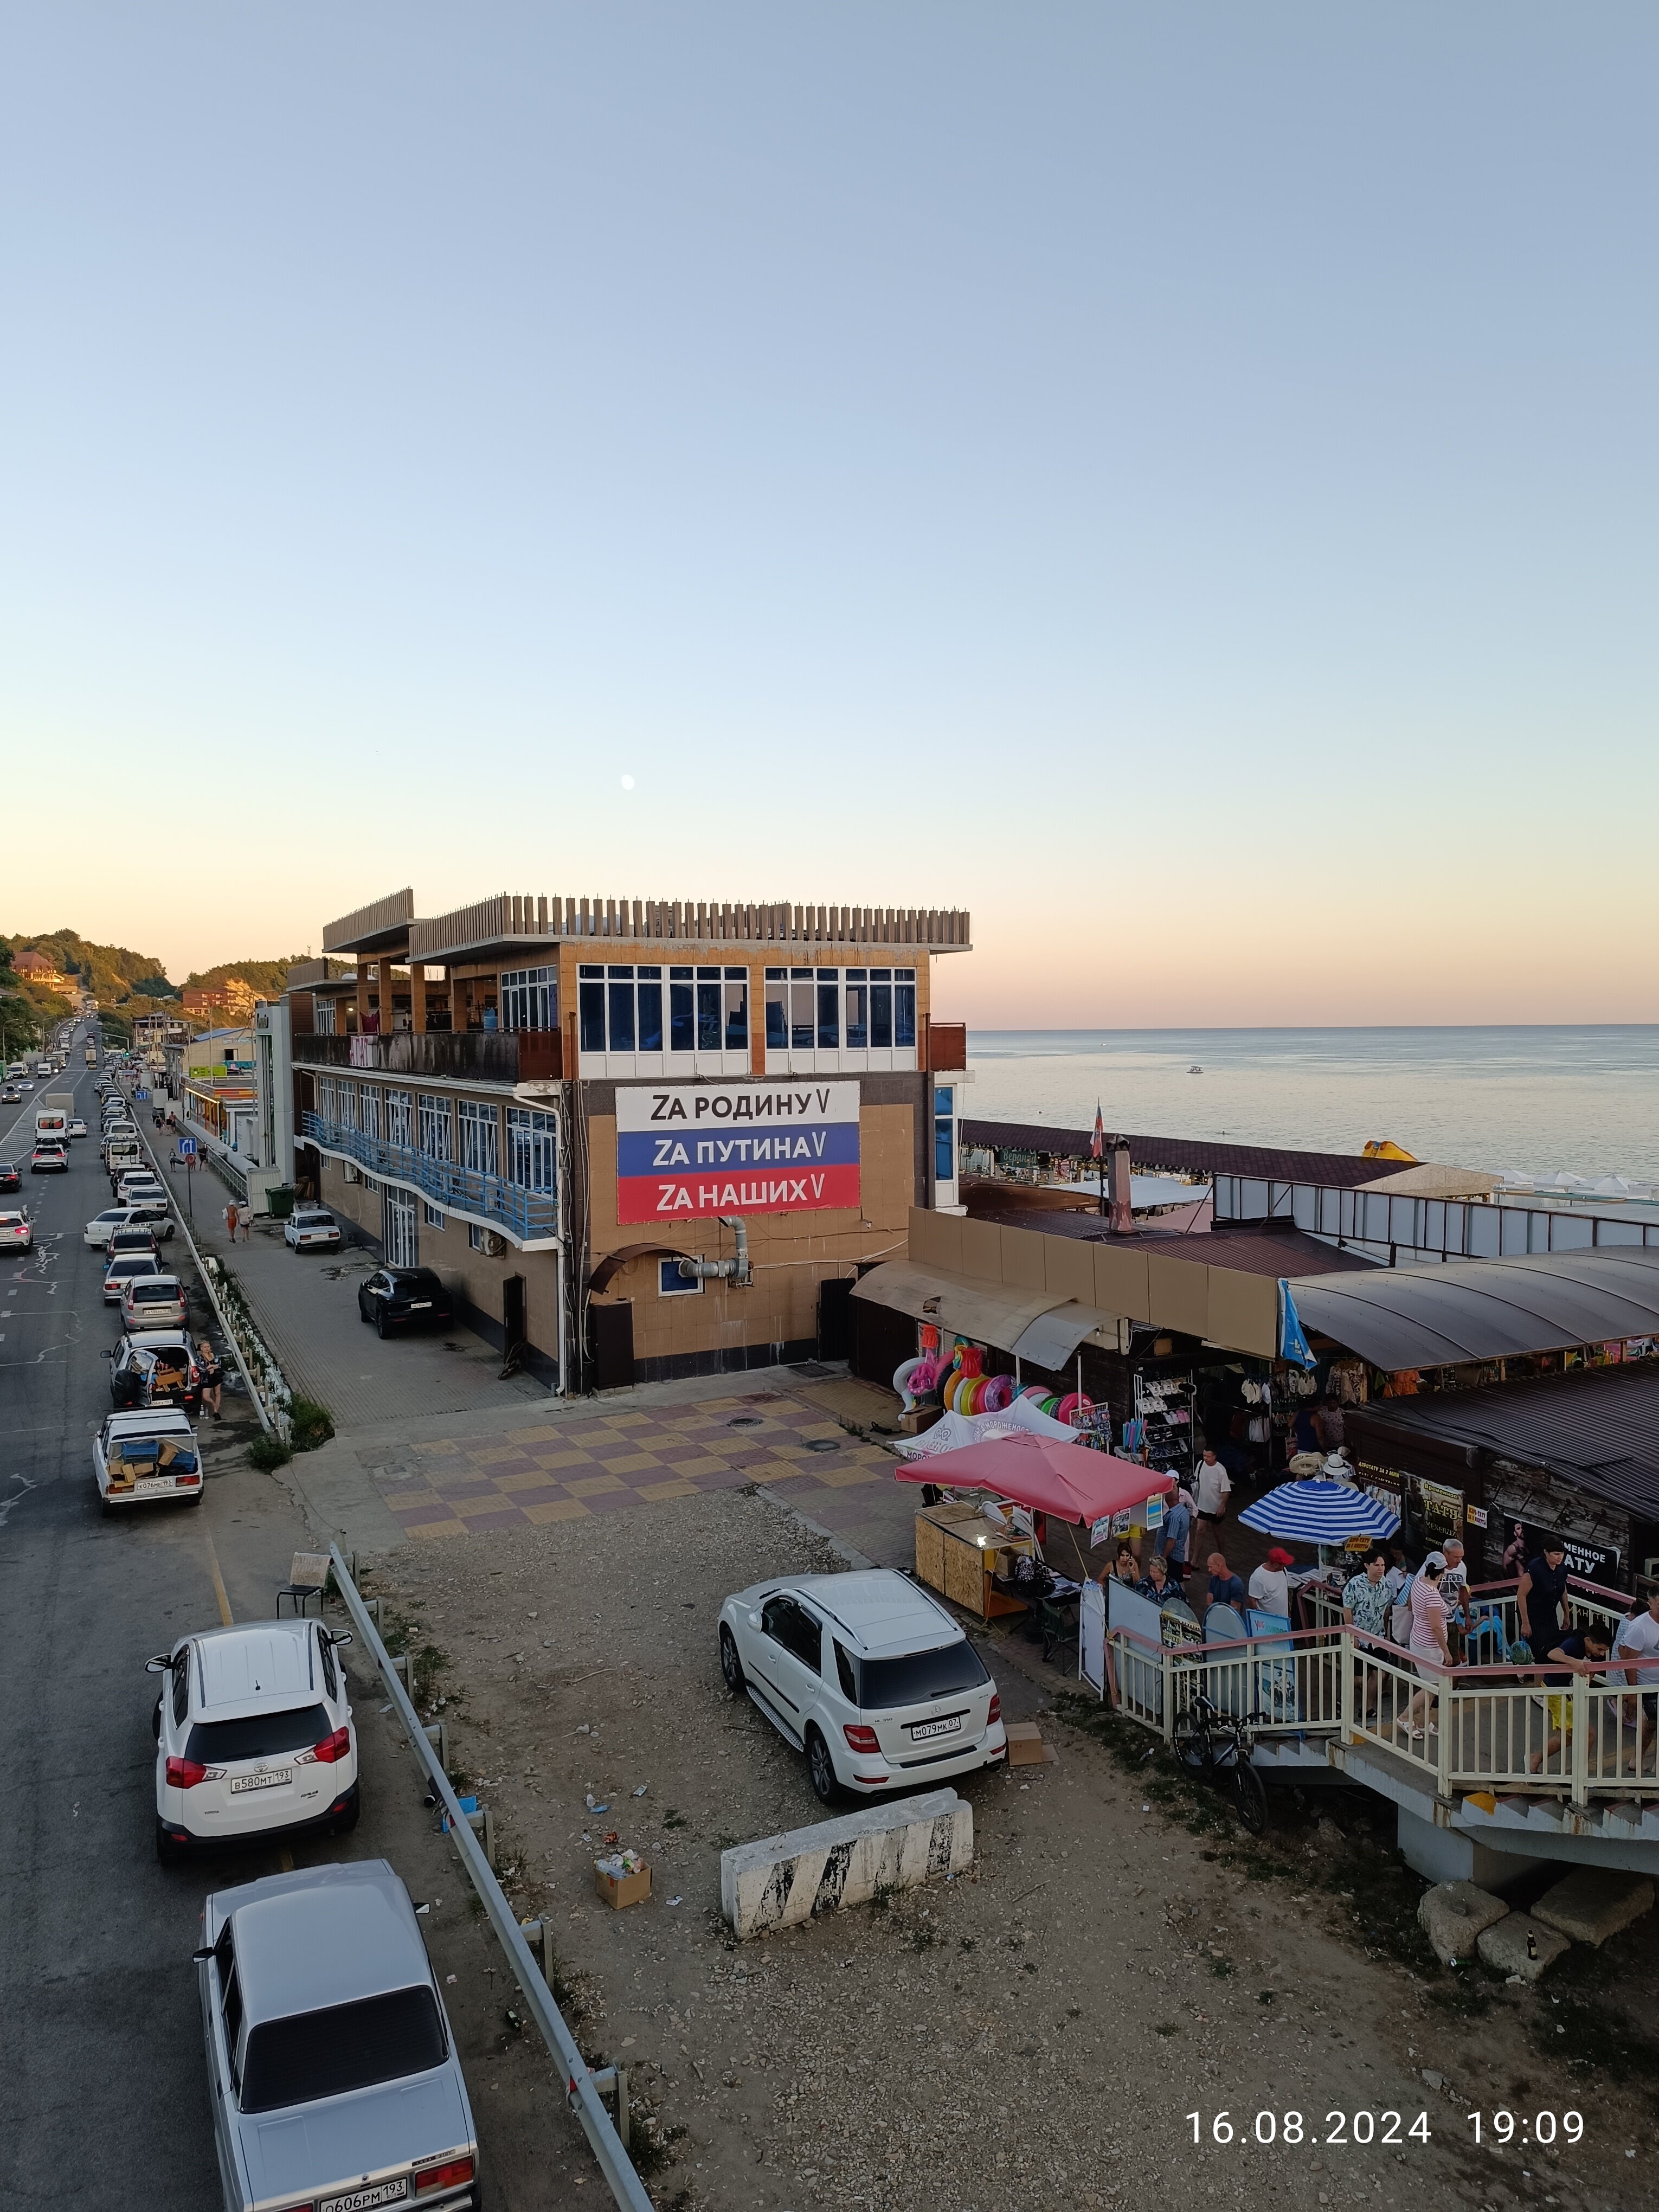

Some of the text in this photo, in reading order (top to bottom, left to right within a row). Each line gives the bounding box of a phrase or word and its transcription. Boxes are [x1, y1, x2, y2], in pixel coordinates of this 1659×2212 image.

[695, 1093, 812, 1120] РОДИНУ
[816, 1089, 830, 1114] V
[1002, 1149, 1038, 1167] Веранда
[699, 1179, 807, 1208] НАШИХ
[811, 1173, 825, 1199] V
[907, 1451, 929, 1461] МОРО
[1424, 1483, 1458, 1499] Временное
[1562, 1542, 1606, 1563] МЕННОЕ
[1564, 1554, 1595, 1573] АТУ
[916, 1724, 947, 1737] М079МК
[235, 1771, 289, 1790] В580МТ 193
[325, 2181, 403, 2212] О606РМ 193
